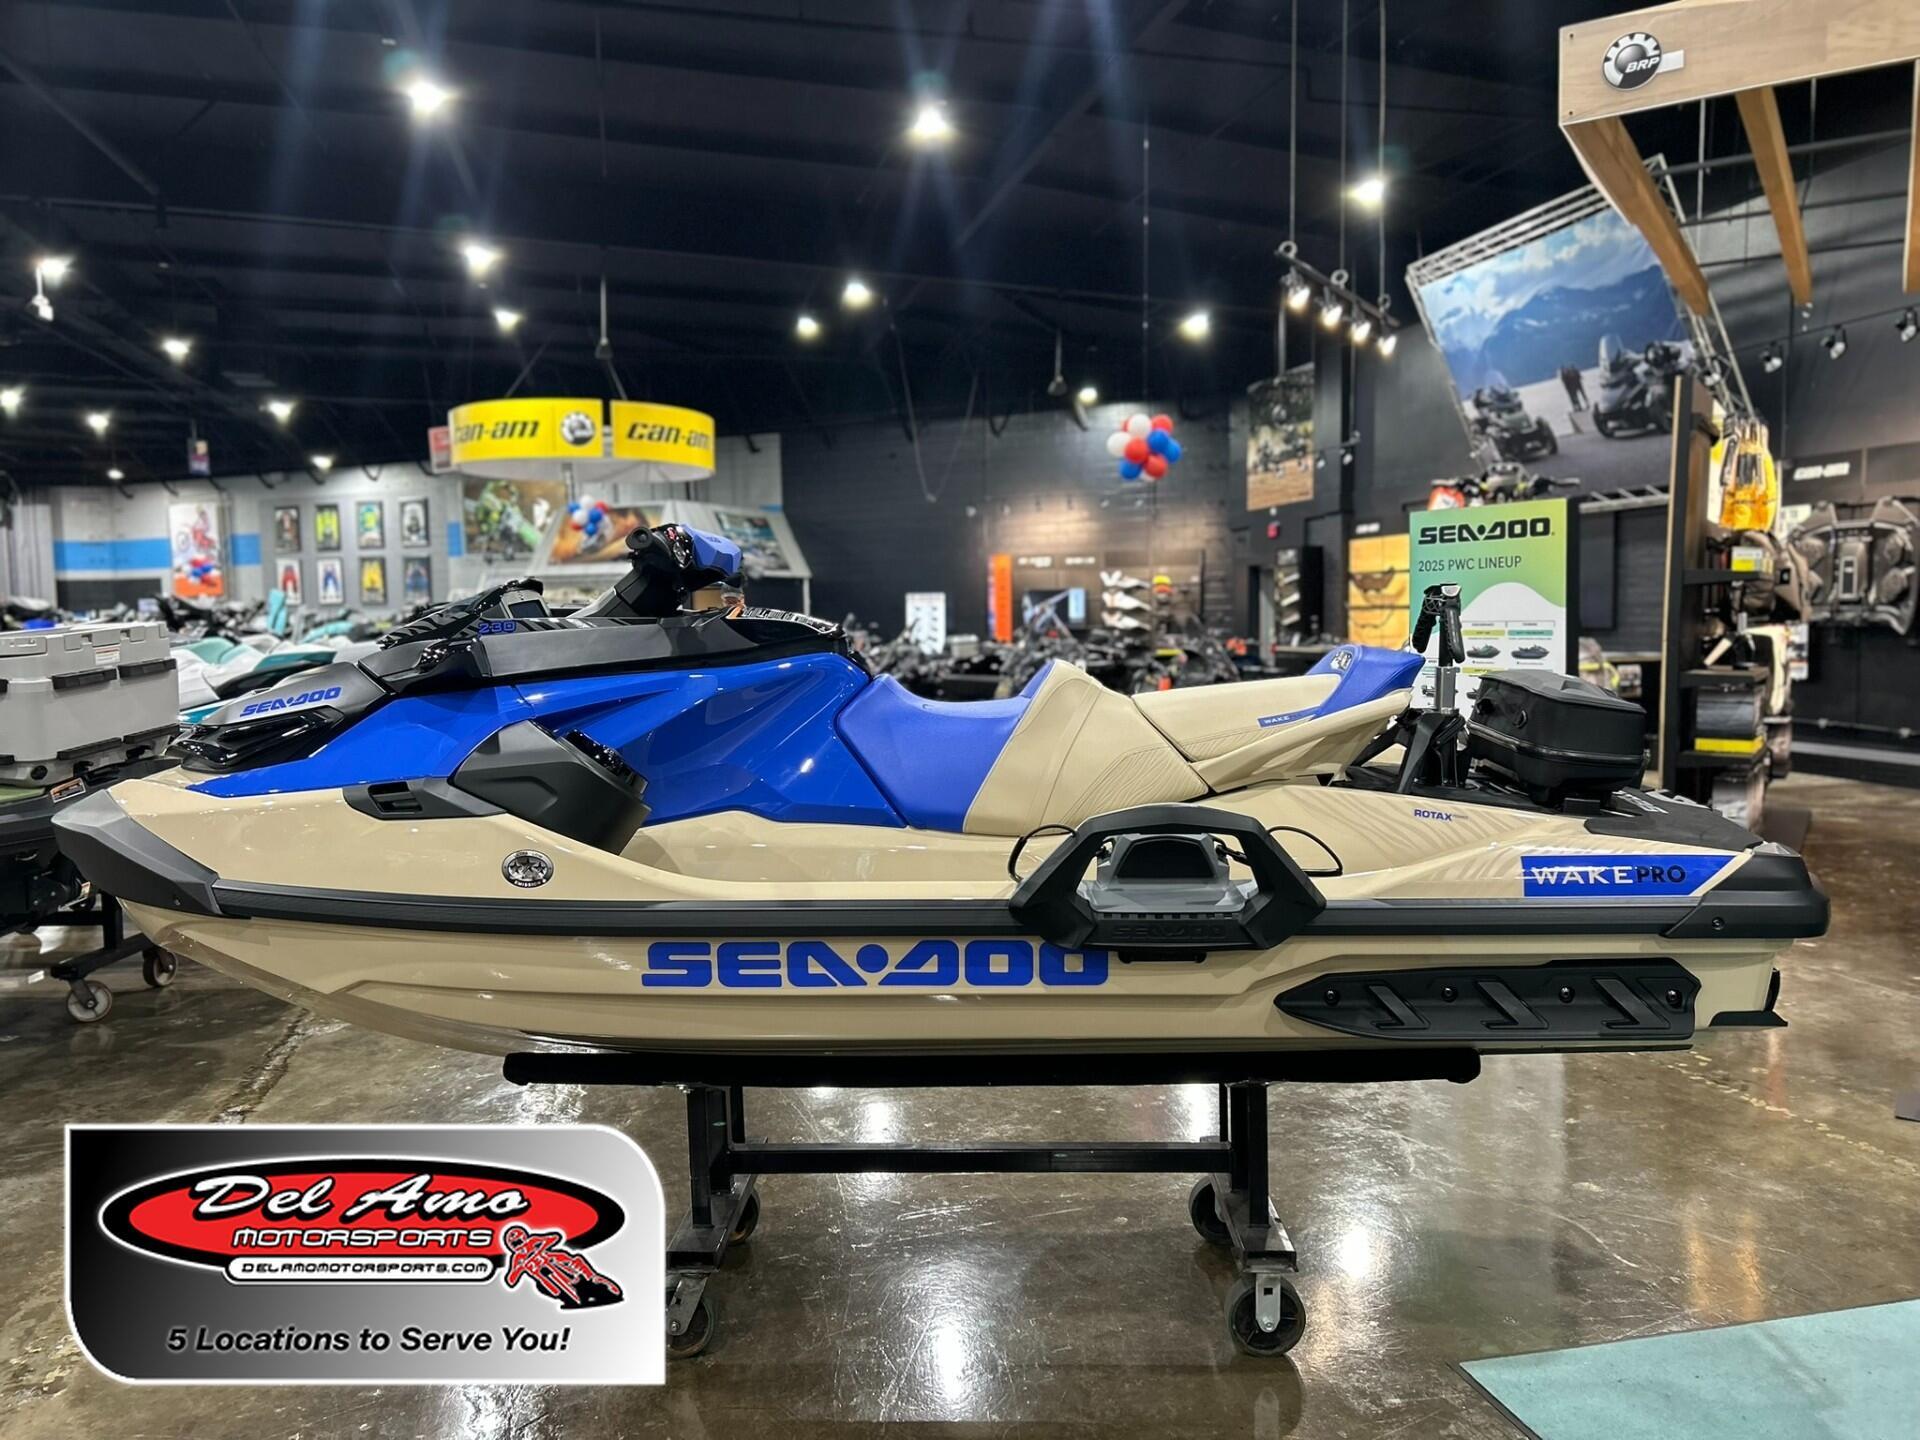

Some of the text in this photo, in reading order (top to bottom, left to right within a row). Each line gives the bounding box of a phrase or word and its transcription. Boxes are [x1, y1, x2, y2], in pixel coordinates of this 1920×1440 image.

[1625, 56, 1660, 73] BRP
[627, 421, 710, 449] can-am
[1418, 555, 1522, 572] 2025 PWC LINEUP
[479, 621, 516, 634] 230
[1414, 809, 1453, 821] ROTAX
